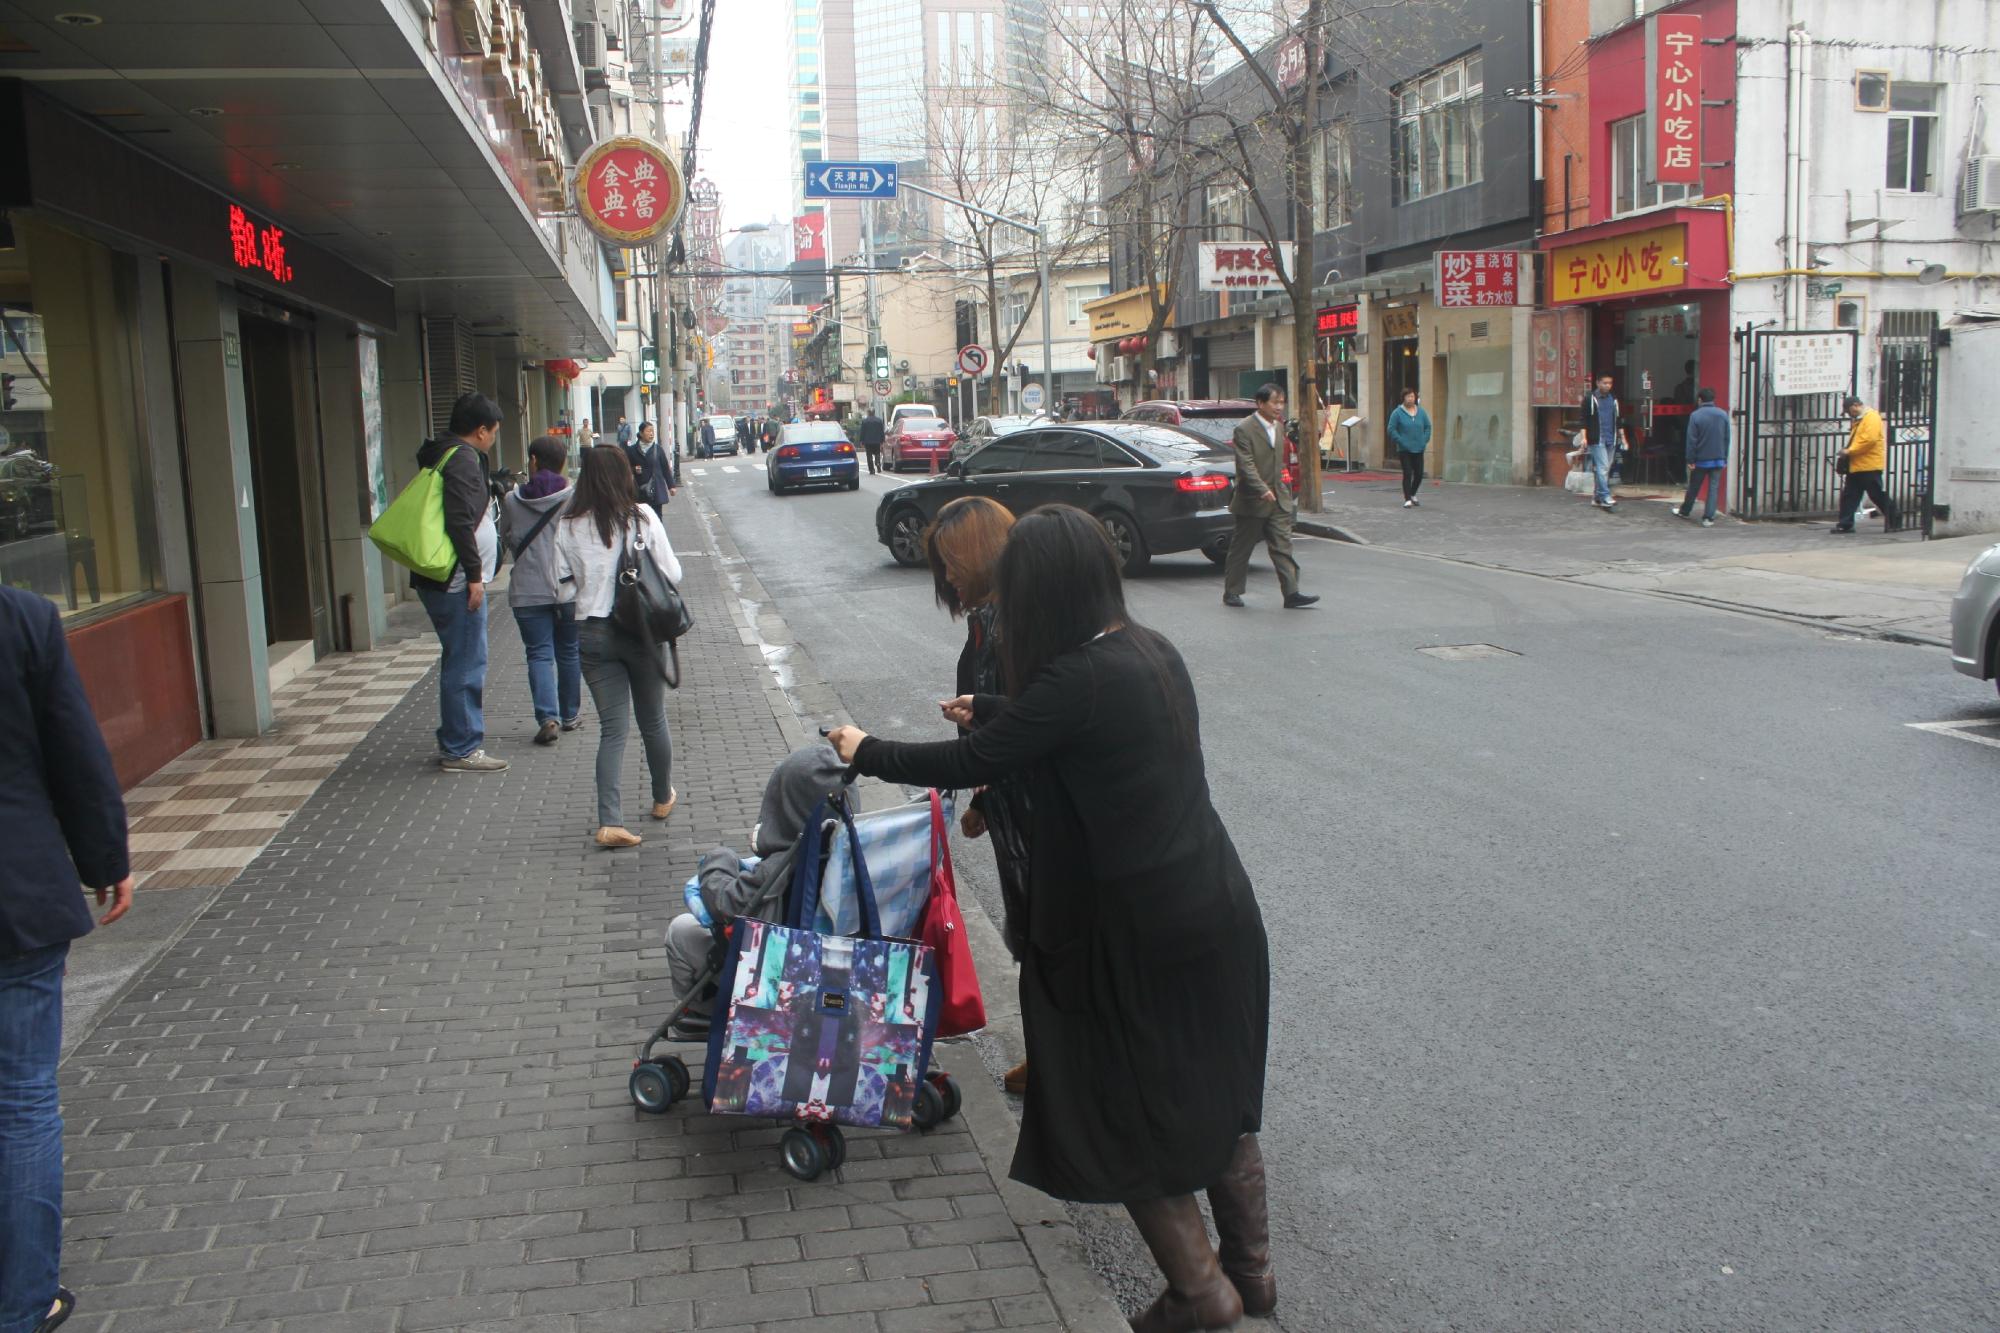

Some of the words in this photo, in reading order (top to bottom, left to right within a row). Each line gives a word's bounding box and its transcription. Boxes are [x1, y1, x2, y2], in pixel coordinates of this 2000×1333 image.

[1664, 31, 1694, 168] 宁心小吃店
[834, 171, 869, 182] 天津路
[834, 183, 857, 191] Tianjin
[1475, 254, 1513, 268] 盖浇饭
[1569, 241, 1662, 294] 宁心小吃
[1445, 254, 1473, 305] 炒菜
[1476, 291, 1513, 305] 北方水饺
